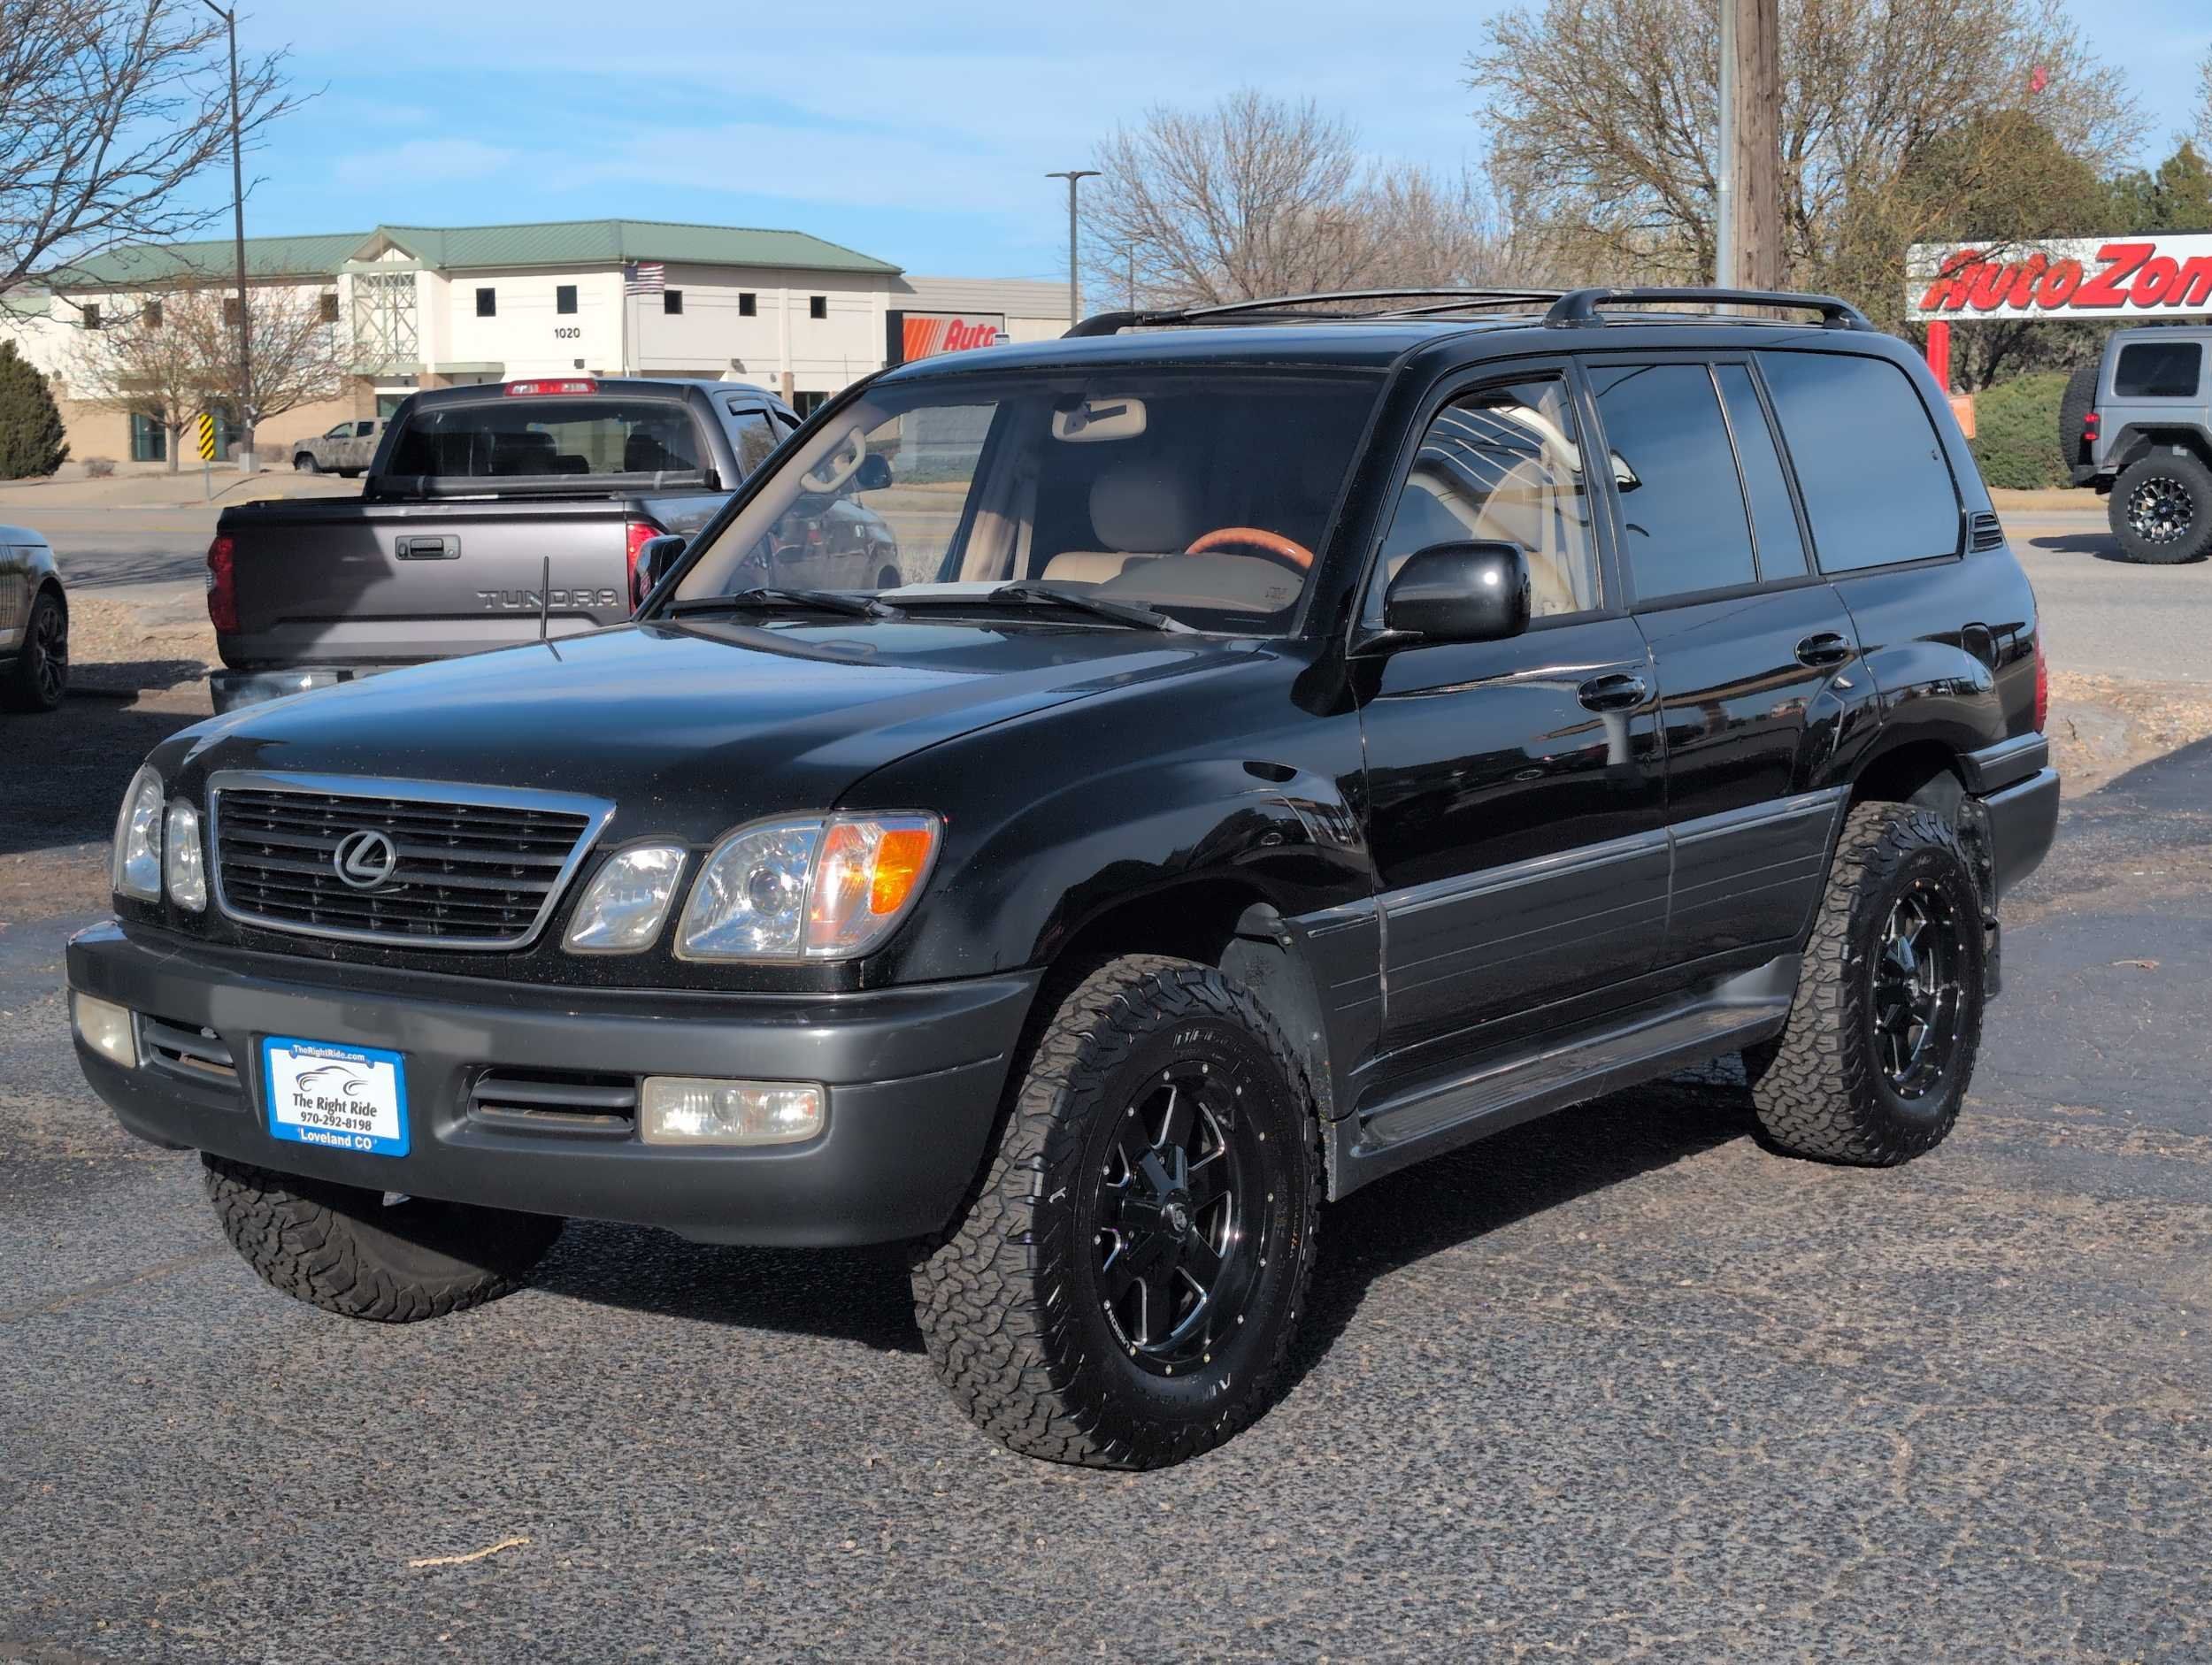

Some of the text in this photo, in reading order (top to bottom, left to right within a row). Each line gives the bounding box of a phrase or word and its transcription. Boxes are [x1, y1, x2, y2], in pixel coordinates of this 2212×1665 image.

[554, 327, 580, 339] 1020
[476, 588, 618, 609] TUNDRA
[293, 1044, 365, 1062] TheRightRide.com
[293, 1093, 377, 1117] The Right Ride
[301, 1111, 372, 1132] 970-292-8198
[301, 1130, 372, 1149] Loveland CO
